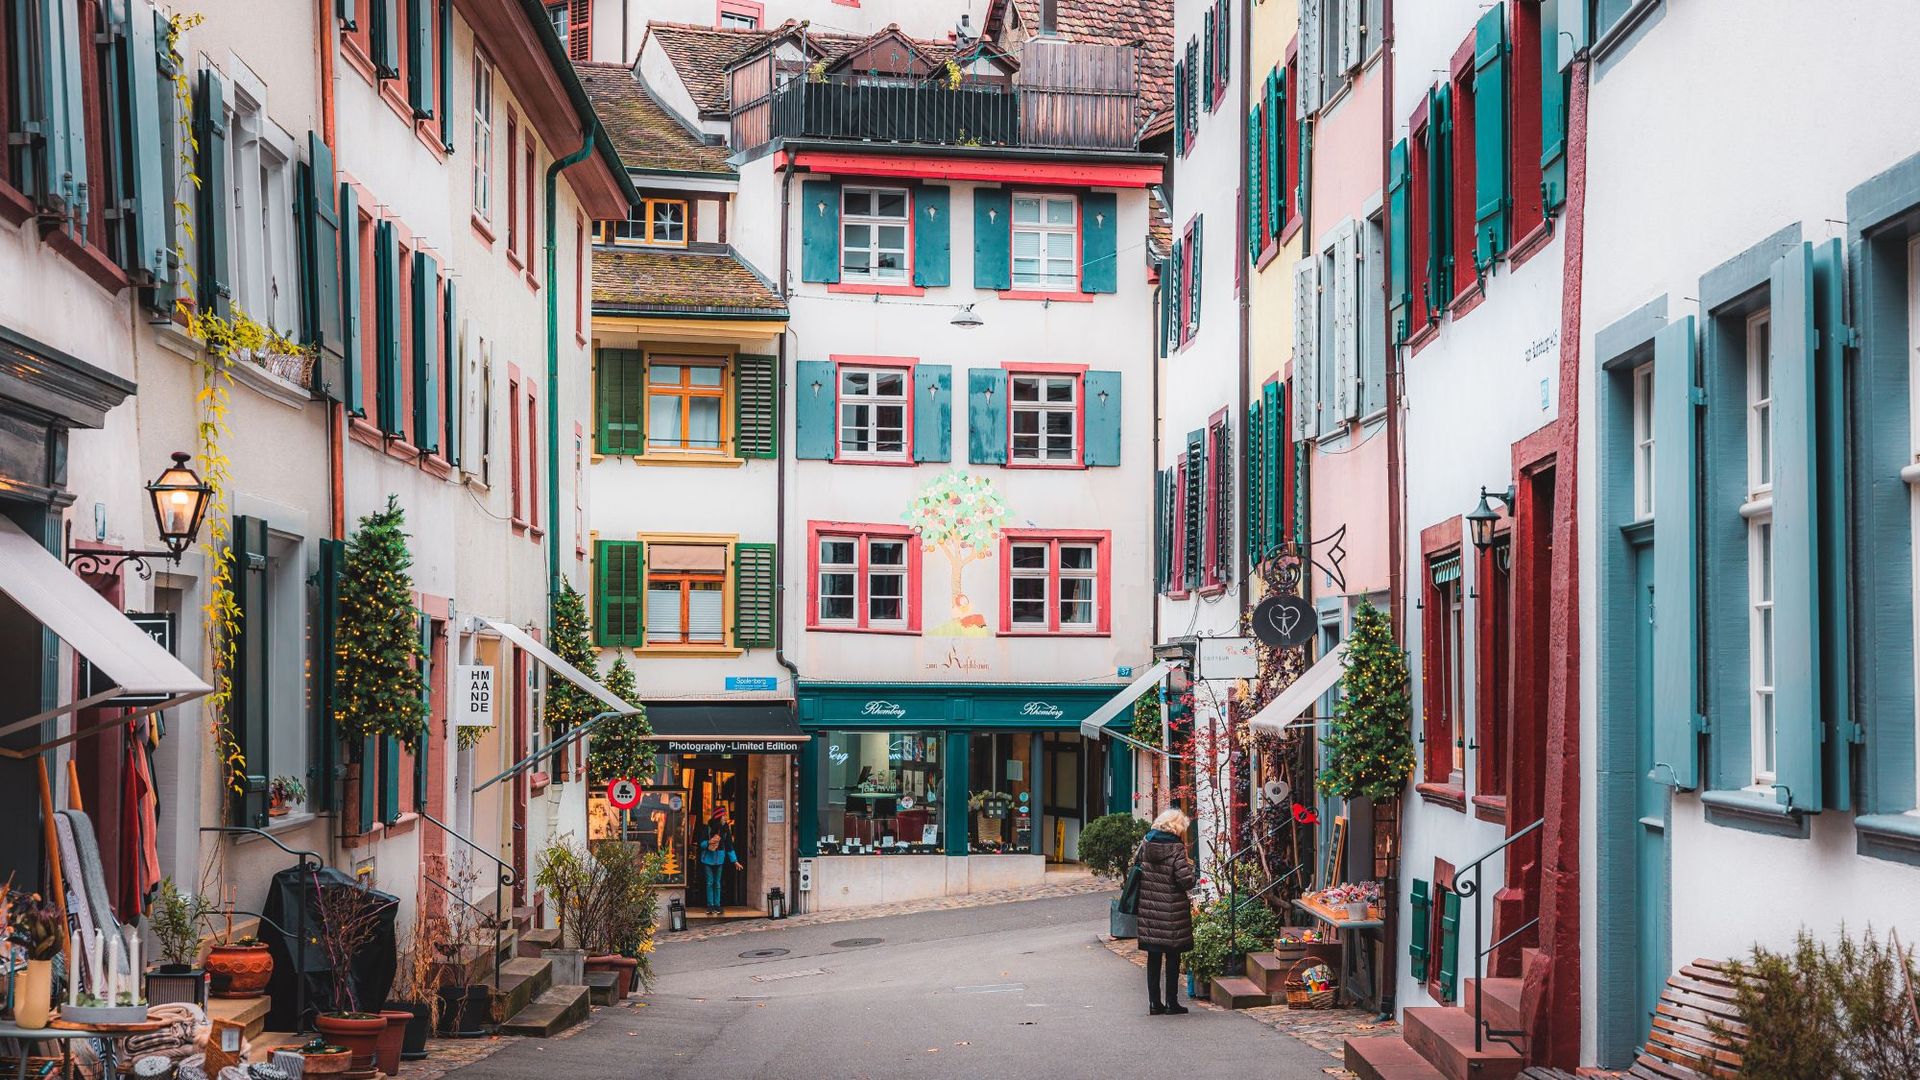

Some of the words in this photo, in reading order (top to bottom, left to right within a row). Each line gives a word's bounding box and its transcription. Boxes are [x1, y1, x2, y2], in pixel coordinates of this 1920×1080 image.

[861, 700, 906, 719] Rhomberg
[1020, 701, 1064, 719] Rhomberg
[766, 741, 798, 750] Edition
